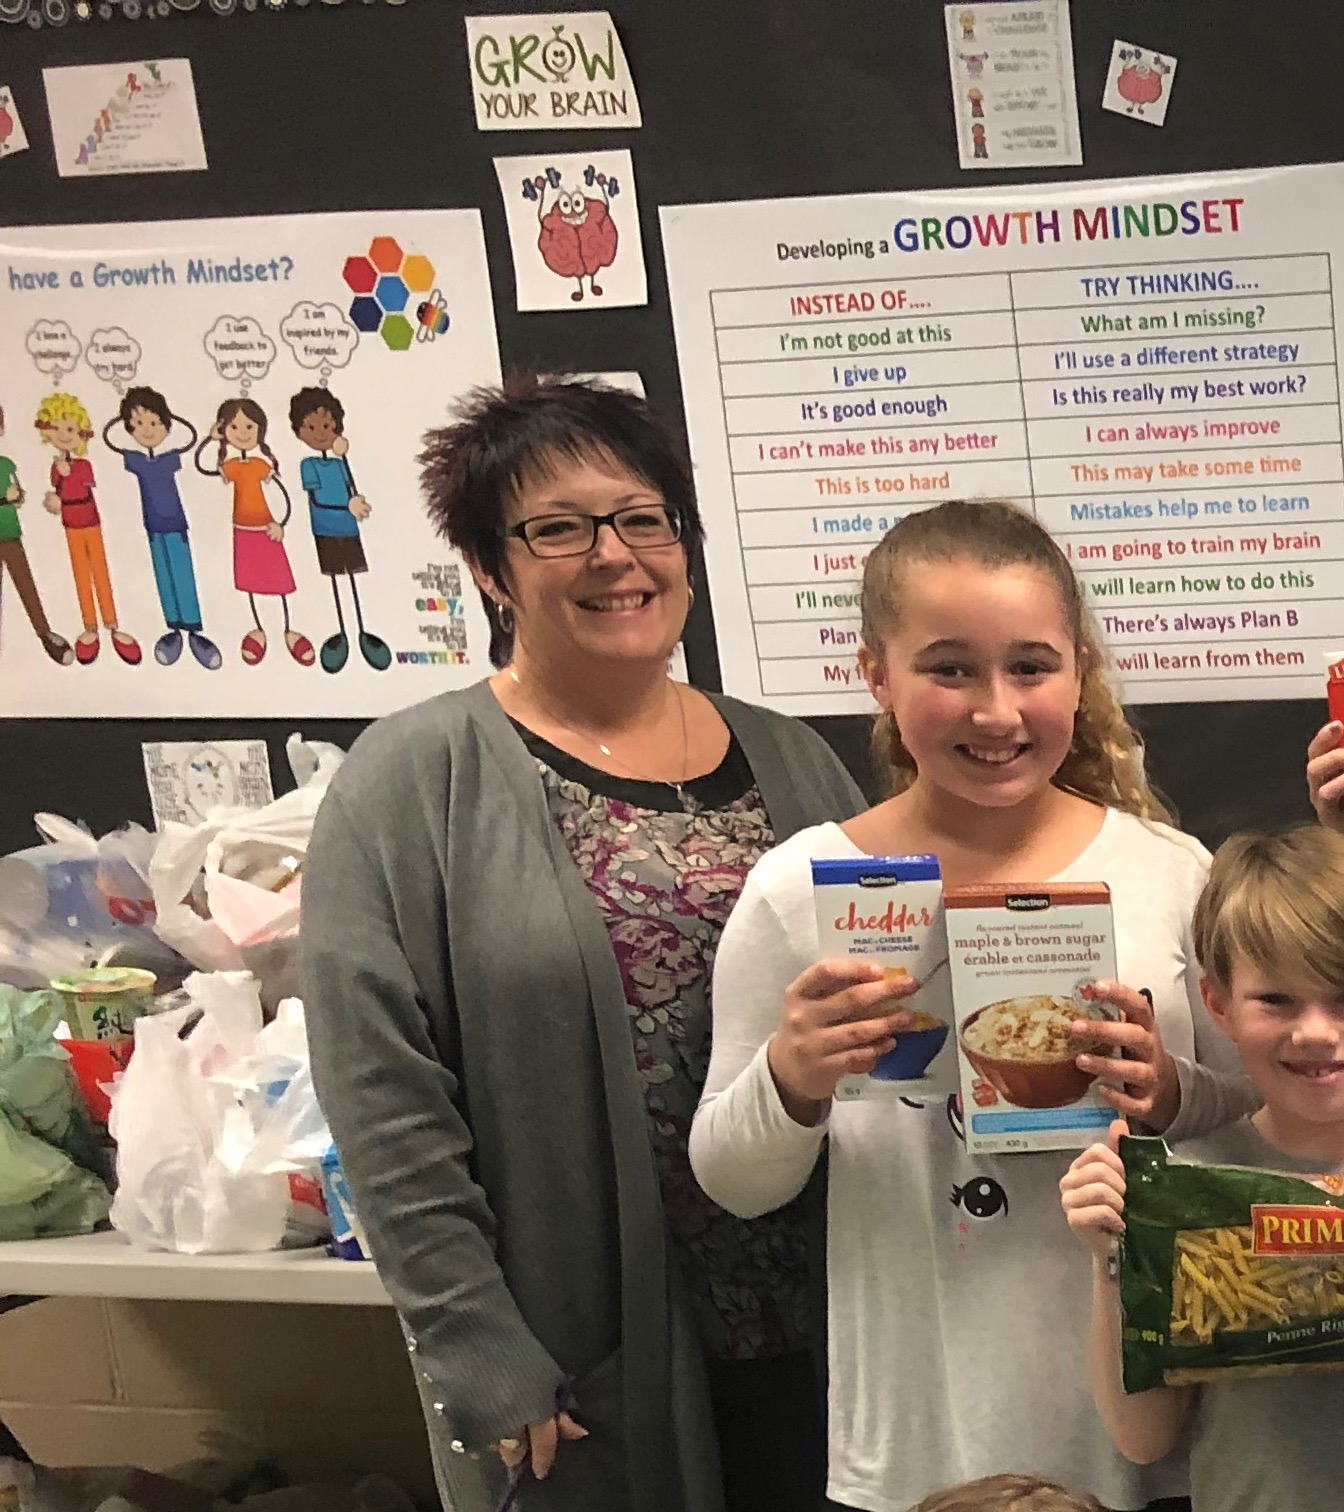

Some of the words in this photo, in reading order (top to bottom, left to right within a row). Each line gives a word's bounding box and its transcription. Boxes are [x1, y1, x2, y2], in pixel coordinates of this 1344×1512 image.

[475, 30, 615, 87] GROW
[480, 93, 539, 118] YOUR
[550, 89, 628, 117] BRAIN
[776, 238, 875, 261] Developing
[880, 240, 889, 254] a
[893, 209, 1060, 253] GROWTH
[1073, 198, 1244, 242] MINDSET
[8, 266, 60, 291] have
[70, 270, 83, 288] a
[94, 262, 176, 288] Growth
[187, 256, 294, 284] Mindset?
[1081, 277, 1120, 298] TRY
[790, 292, 875, 316] INSTEAD
[1081, 313, 1132, 332] What
[1138, 315, 1168, 330] am
[1173, 311, 1178, 328] I
[1185, 305, 1266, 329] missing?
[780, 334, 808, 351] I'm
[813, 332, 842, 349] not
[848, 328, 891, 351] good
[897, 328, 913, 344] at
[919, 324, 951, 343] this
[1055, 352, 1076, 369] I'll
[1083, 352, 1114, 368] use
[1121, 352, 1130, 366] a
[1137, 346, 1218, 366] different
[1224, 341, 1299, 364] strategy
[833, 366, 838, 383] I
[844, 362, 878, 387] give
[885, 365, 907, 384] up
[1053, 388, 1068, 405] Is
[1073, 386, 1107, 404] this
[1113, 382, 1164, 405] really
[1170, 382, 1198, 402] my
[1204, 380, 1244, 397] best
[1250, 375, 1306, 395] work?
[802, 402, 828, 421] It's
[832, 398, 876, 422] good
[882, 394, 947, 418] enough
[1086, 426, 1090, 443] I
[1098, 427, 1129, 442] can
[1135, 422, 1198, 444] always
[1204, 418, 1280, 438] improve
[758, 444, 763, 460] I
[770, 441, 813, 460] can't
[819, 442, 865, 457] make
[871, 437, 902, 454] this
[909, 438, 938, 455] any
[944, 432, 998, 451] better
[1071, 464, 1108, 482] This
[1115, 465, 1152, 483] may
[1159, 461, 1199, 479] take
[1205, 459, 1253, 476] some
[1260, 455, 1301, 473] time
[815, 477, 851, 495] This
[856, 476, 869, 493] is
[875, 476, 904, 492] too
[909, 471, 949, 491] hard
[1071, 501, 1152, 521] Mistakes
[1158, 497, 1198, 518] help
[1204, 500, 1232, 514] me
[1238, 497, 1256, 513] to
[1262, 494, 1309, 511] learn
[1078, 546, 1106, 559] am
[1112, 539, 1162, 562] going
[1167, 539, 1185, 554] to
[1191, 536, 1234, 554] train
[1240, 535, 1267, 553] my
[1273, 531, 1321, 549] brain
[1092, 578, 1124, 598] will
[1129, 575, 1176, 595] learn
[1182, 574, 1221, 592] how
[1226, 573, 1245, 591] to
[1251, 571, 1274, 589] do
[1280, 570, 1314, 588] this
[1103, 612, 1168, 634] There's
[1174, 612, 1235, 634] always
[1241, 610, 1280, 628] Plan
[1287, 610, 1298, 626] B
[1117, 654, 1149, 672] will
[1154, 652, 1200, 669] learn
[1206, 651, 1249, 667] from
[1255, 648, 1304, 665] them
[834, 901, 933, 933] cheddar
[955, 935, 999, 950] maple
[1003, 937, 1011, 946] &
[1015, 933, 1061, 946] brown
[1066, 933, 1106, 947] sugar
[964, 951, 1009, 965] érable
[1012, 954, 1024, 963] et
[1027, 949, 1100, 963] cassonade
